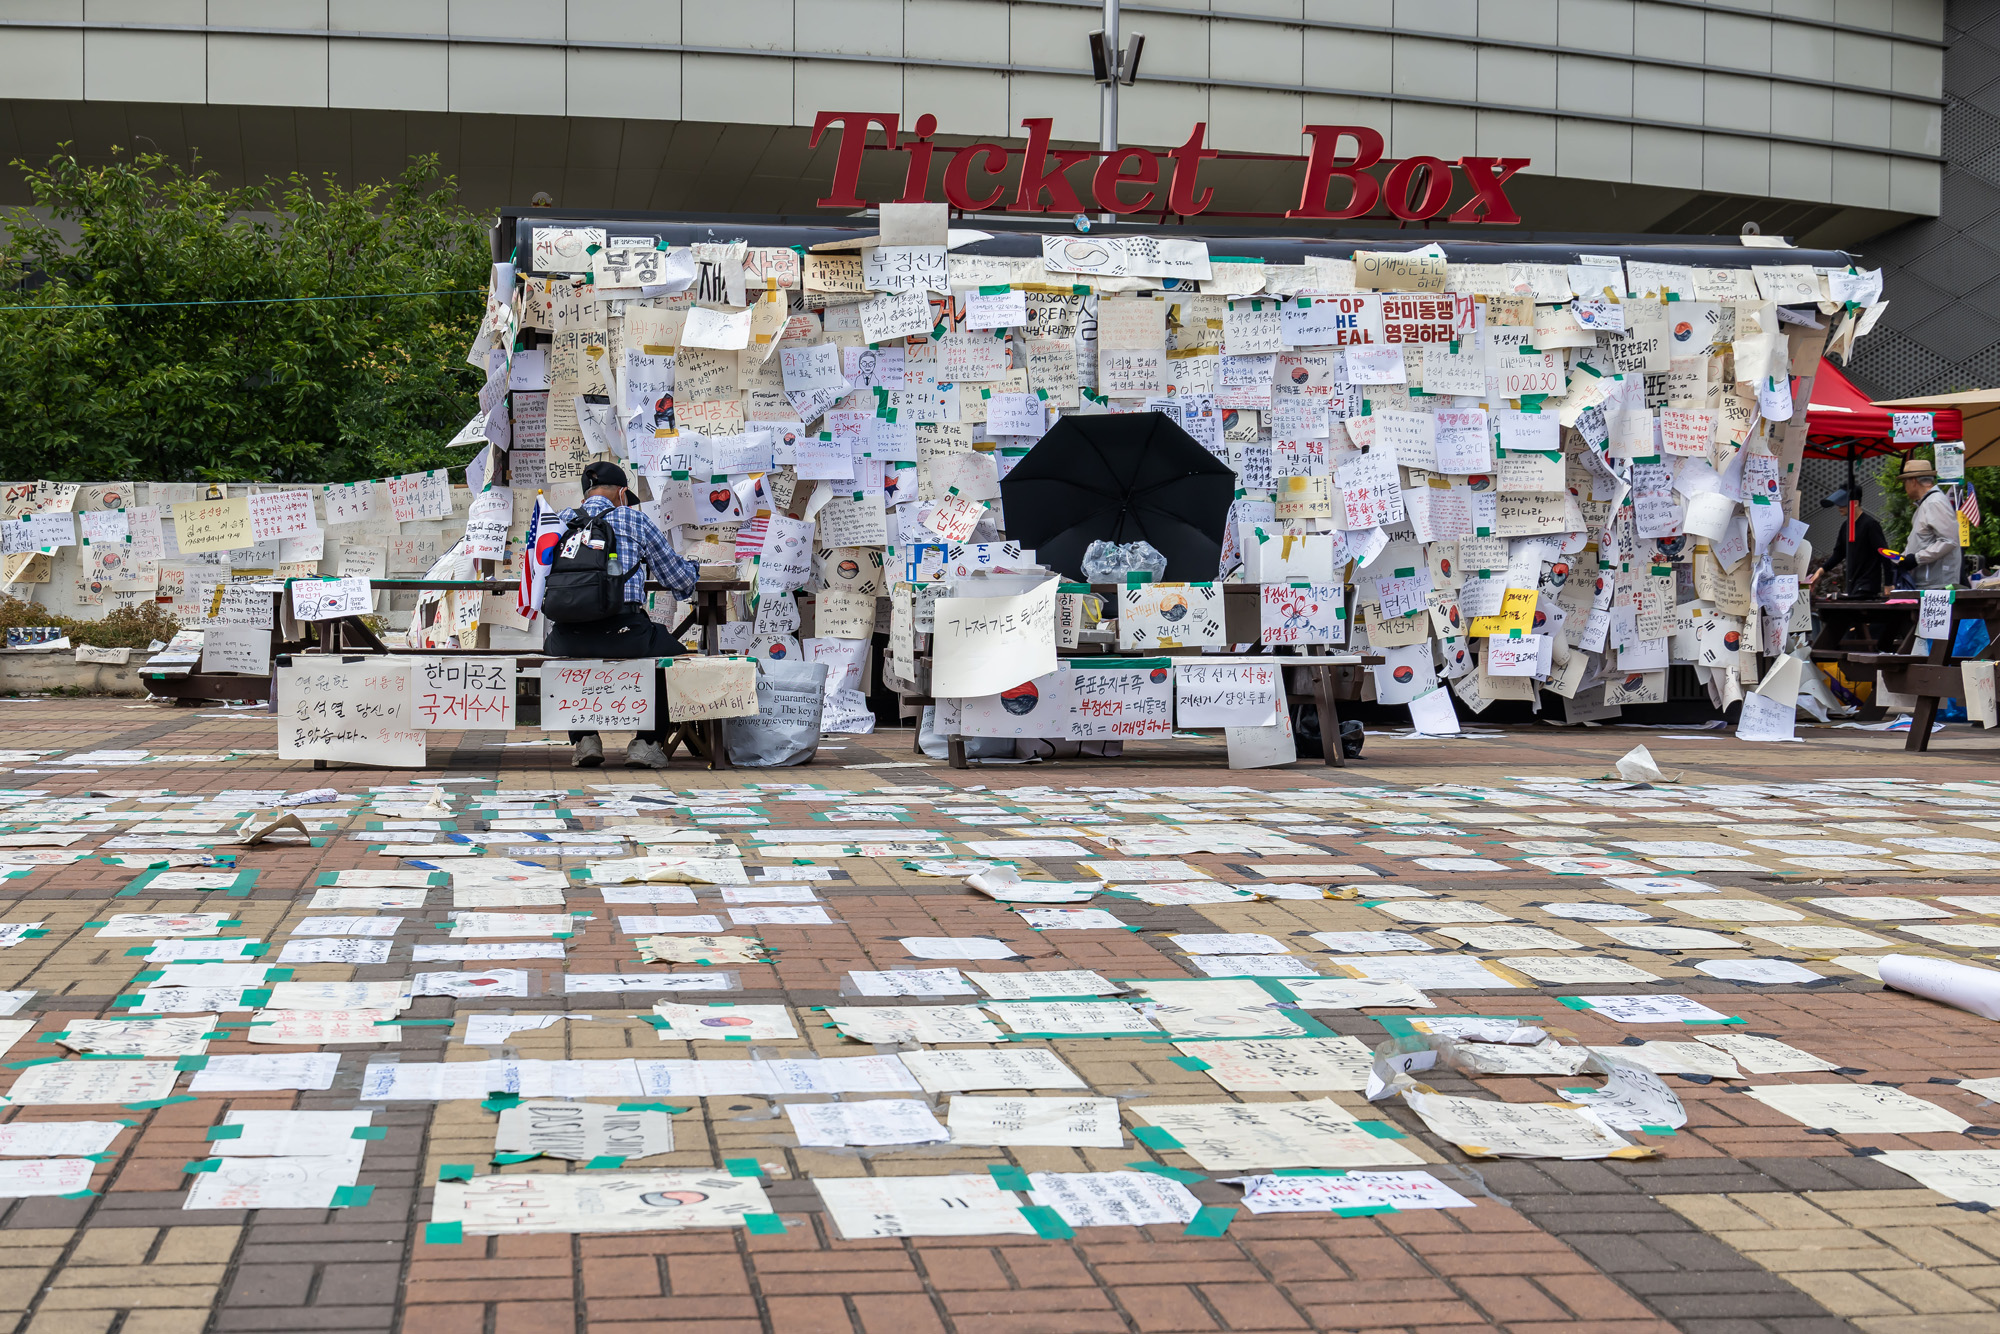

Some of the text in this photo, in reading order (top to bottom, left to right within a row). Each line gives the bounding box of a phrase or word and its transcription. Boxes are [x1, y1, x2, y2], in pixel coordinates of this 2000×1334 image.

[809, 111, 1531, 225] Ticket Box
[602, 249, 660, 284] 부정
[743, 249, 800, 288] 사형
[871, 251, 947, 273] 부정선거
[1417, 276, 1444, 289] 하라
[558, 302, 600, 326] 아니다
[1383, 300, 1454, 321] 한미동맹
[1385, 324, 1457, 344] 영원하라
[1493, 334, 1529, 346] 부정선거
[1544, 354, 1554, 368] 힘
[1507, 372, 1557, 392] 10 20 30
[752, 391, 780, 399] Freedom
[1305, 385, 1333, 396] 수개표!
[674, 400, 742, 421] 한미공조
[1895, 425, 1933, 437] A-WEB
[1276, 440, 1324, 455] 주의 빛을
[1287, 453, 1324, 466] 발하게
[1278, 465, 1312, 477] 하소서
[1278, 502, 1330, 514] 부정선거 재선거
[1500, 507, 1543, 519] 우리나라
[1388, 530, 1416, 543] 재선거
[295, 581, 332, 593] 부정선거
[1263, 584, 1341, 604] 부정선거 재선거
[762, 600, 795, 619] 부정선거
[949, 614, 1017, 638] 가져가도
[1157, 624, 1190, 637] 재선거
[1377, 619, 1415, 634] 재선거
[814, 642, 856, 658] Freedom
[424, 662, 507, 690] 한미공조
[554, 668, 644, 686] 1989 06 04
[1211, 667, 1238, 682] 선거
[1241, 667, 1274, 685] 사형!
[295, 674, 405, 696] 영원한 대통령
[621, 683, 643, 694] 사건
[1074, 674, 1145, 695] 투표용지부족
[559, 698, 649, 715] 2026 06 03
[708, 699, 729, 712] 다시
[730, 698, 744, 711] 해
[774, 695, 818, 705] guarantees
[1079, 697, 1167, 717] 부정선거 대통령
[1181, 693, 1212, 706] 재선거
[296, 699, 401, 721] 윤석열 당신이
[418, 693, 510, 725] 국제수사
[781, 705, 795, 714] The
[798, 706, 812, 716] key
[737, 718, 760, 728] giving
[1071, 719, 1171, 736] 책임 이재명하야
[1366, 1182, 1445, 1191] STEAL
